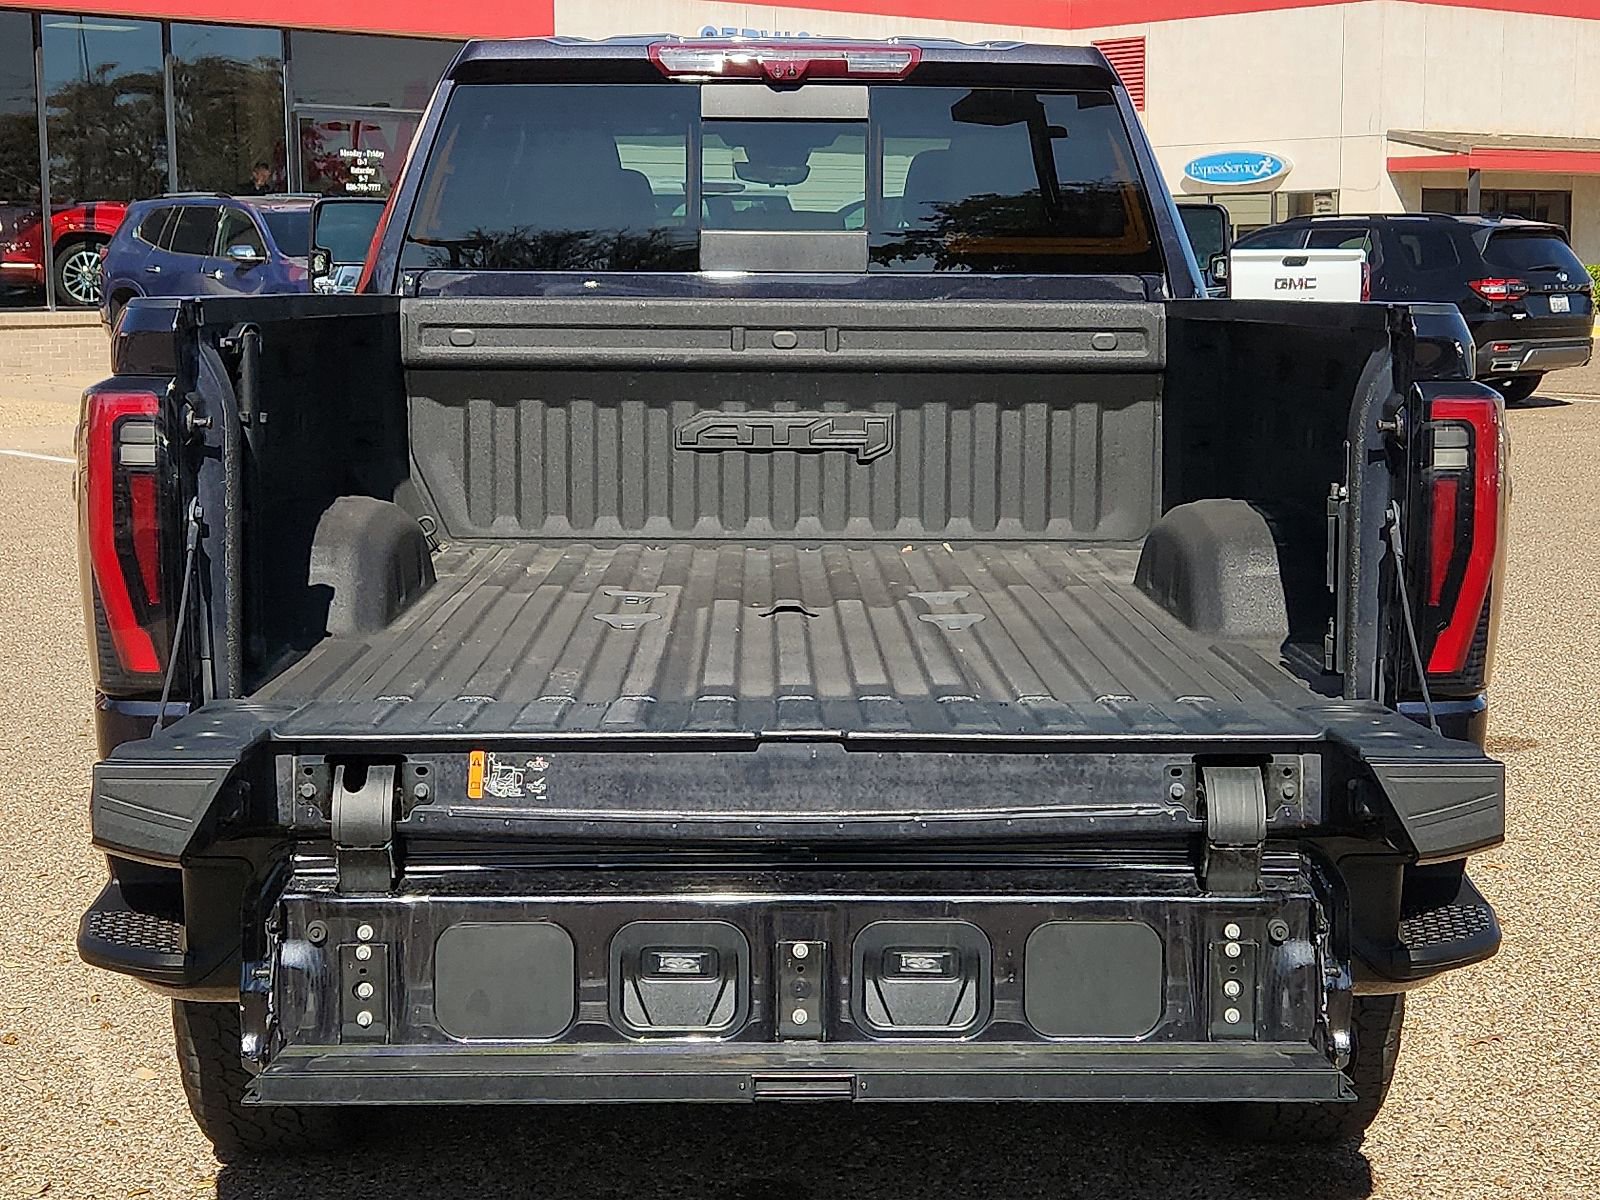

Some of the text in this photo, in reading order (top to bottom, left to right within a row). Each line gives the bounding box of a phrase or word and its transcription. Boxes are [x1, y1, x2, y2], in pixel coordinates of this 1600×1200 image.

[367, 149, 384, 159] Friday
[1274, 278, 1317, 290] GMC
[677, 414, 891, 461] AT4
